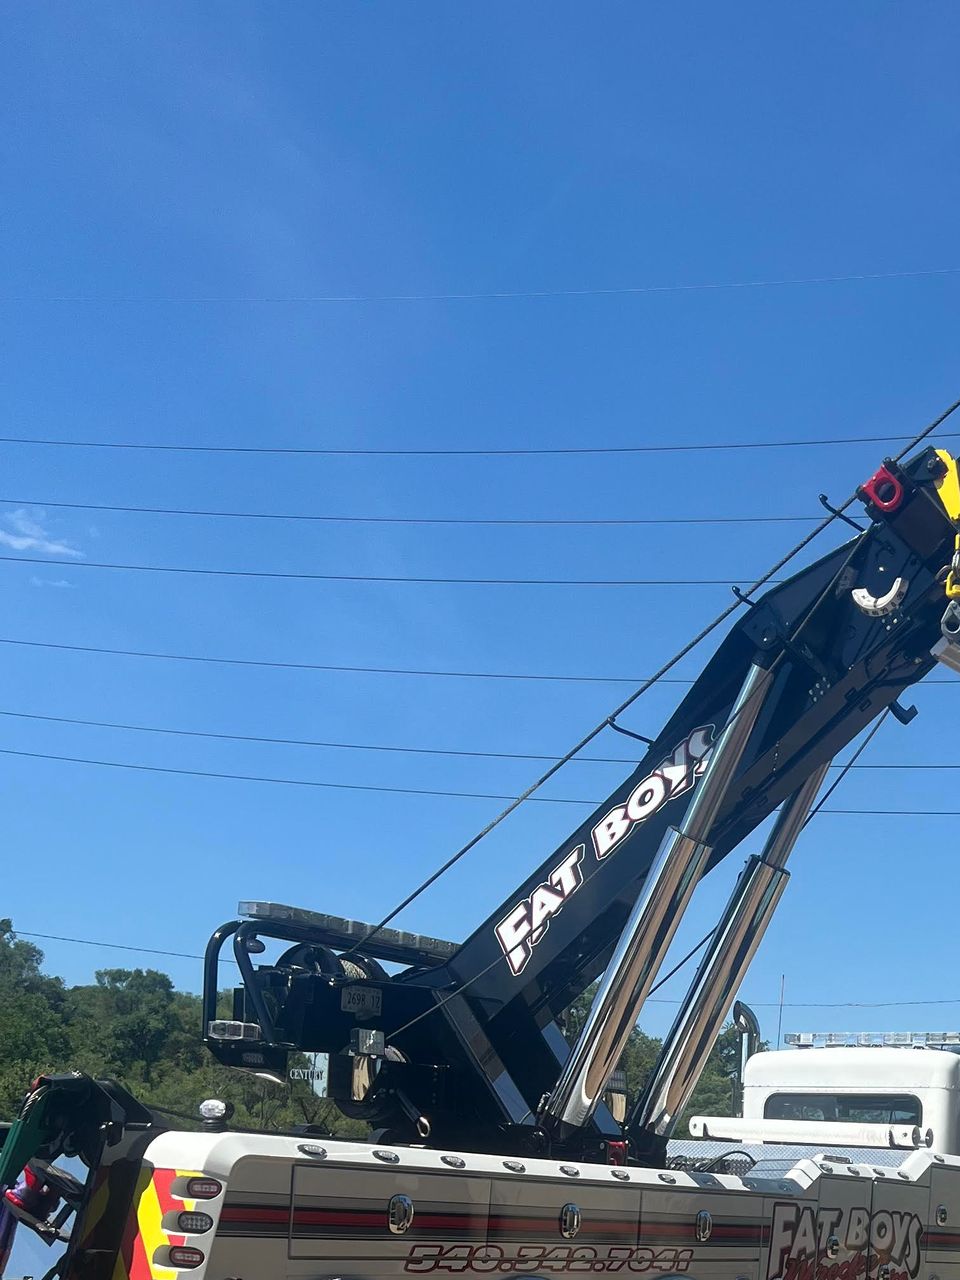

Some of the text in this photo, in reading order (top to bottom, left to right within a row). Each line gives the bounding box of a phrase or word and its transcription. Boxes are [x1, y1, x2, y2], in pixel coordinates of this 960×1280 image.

[494, 843, 585, 976] FAT
[289, 1068, 324, 1081] CENTURY
[403, 1244, 694, 1274] 540.342.7041
[845, 1206, 924, 1280] BOYS
